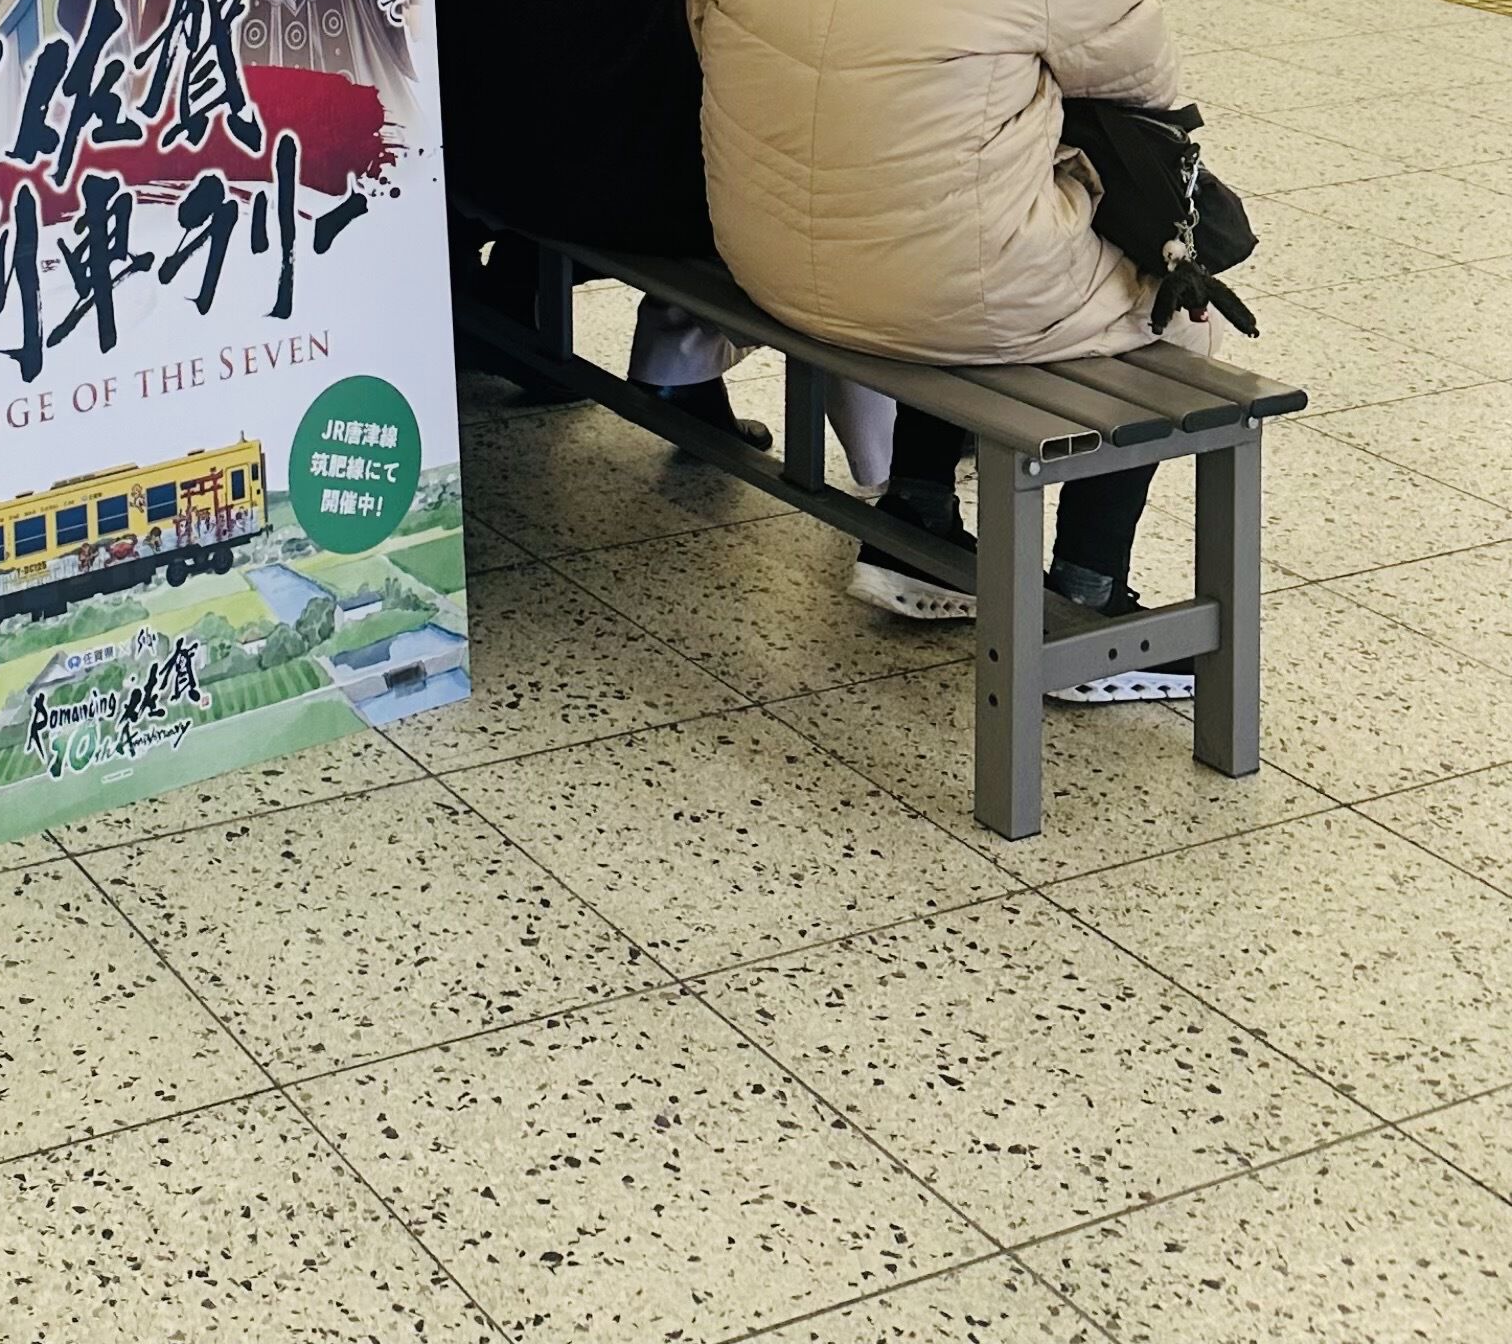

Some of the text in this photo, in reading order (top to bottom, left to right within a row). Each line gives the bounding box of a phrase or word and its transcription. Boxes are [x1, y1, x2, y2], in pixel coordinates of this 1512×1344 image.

[72, 377, 119, 413] OF
[135, 357, 206, 399] THE
[218, 329, 333, 381] SEVEN
[321, 419, 399, 449] JR唐津線
[310, 452, 400, 483] 筑肥線にて
[320, 488, 384, 517] 開催中!
[82, 645, 115, 664] 佐賀県
[26, 637, 201, 759] Romancing 佐賀
